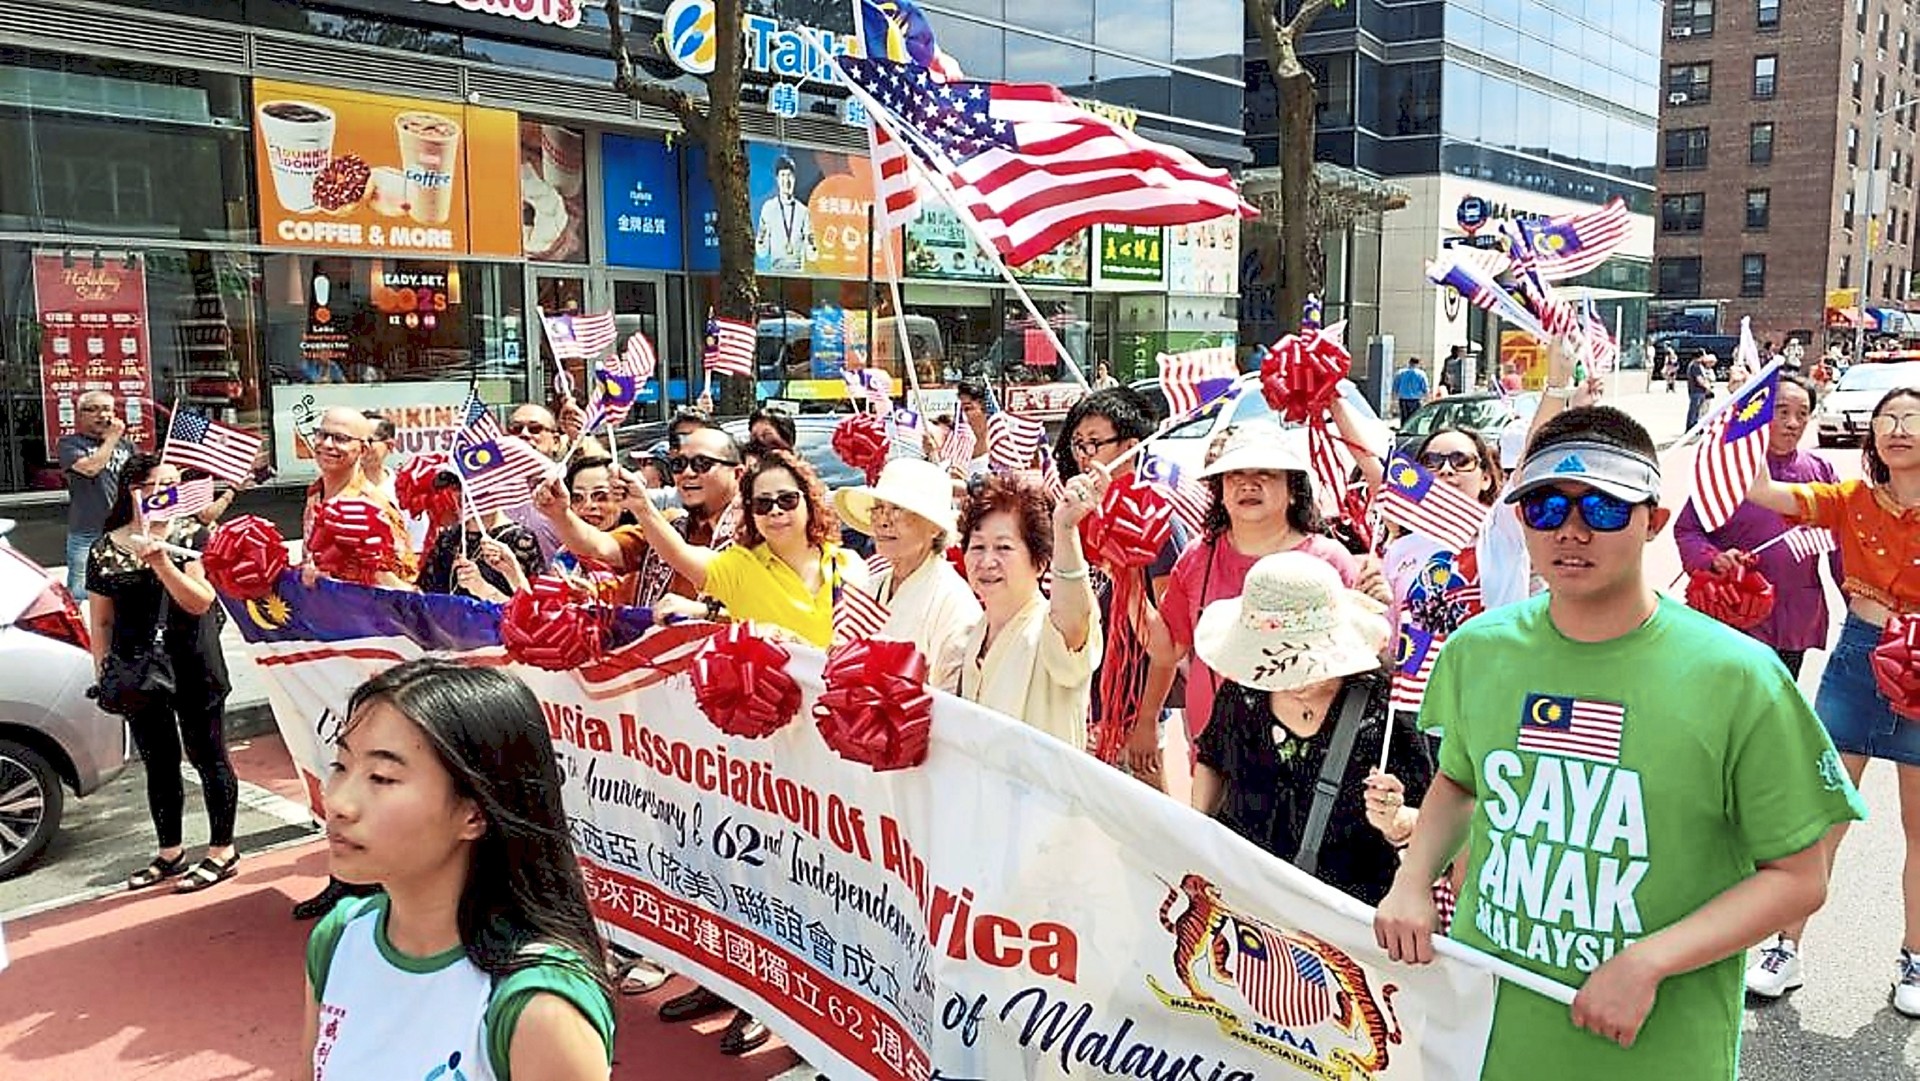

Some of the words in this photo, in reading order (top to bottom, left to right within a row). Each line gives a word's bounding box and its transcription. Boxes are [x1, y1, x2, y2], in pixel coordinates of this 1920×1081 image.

[405, 168, 450, 188] Coffee
[278, 219, 363, 244] COFFEE
[368, 225, 385, 246] &
[389, 226, 453, 248] MORE
[384, 273, 420, 286] EADY.
[583, 757, 687, 848] Anniversary
[618, 712, 821, 840] Association
[826, 793, 872, 862] Of
[1483, 749, 1648, 858] SAYA
[1478, 829, 1650, 935] ANAK
[1475, 896, 1638, 973] MALAYSI
[942, 992, 988, 1049] of
[1253, 1022, 1318, 1057] MAA
